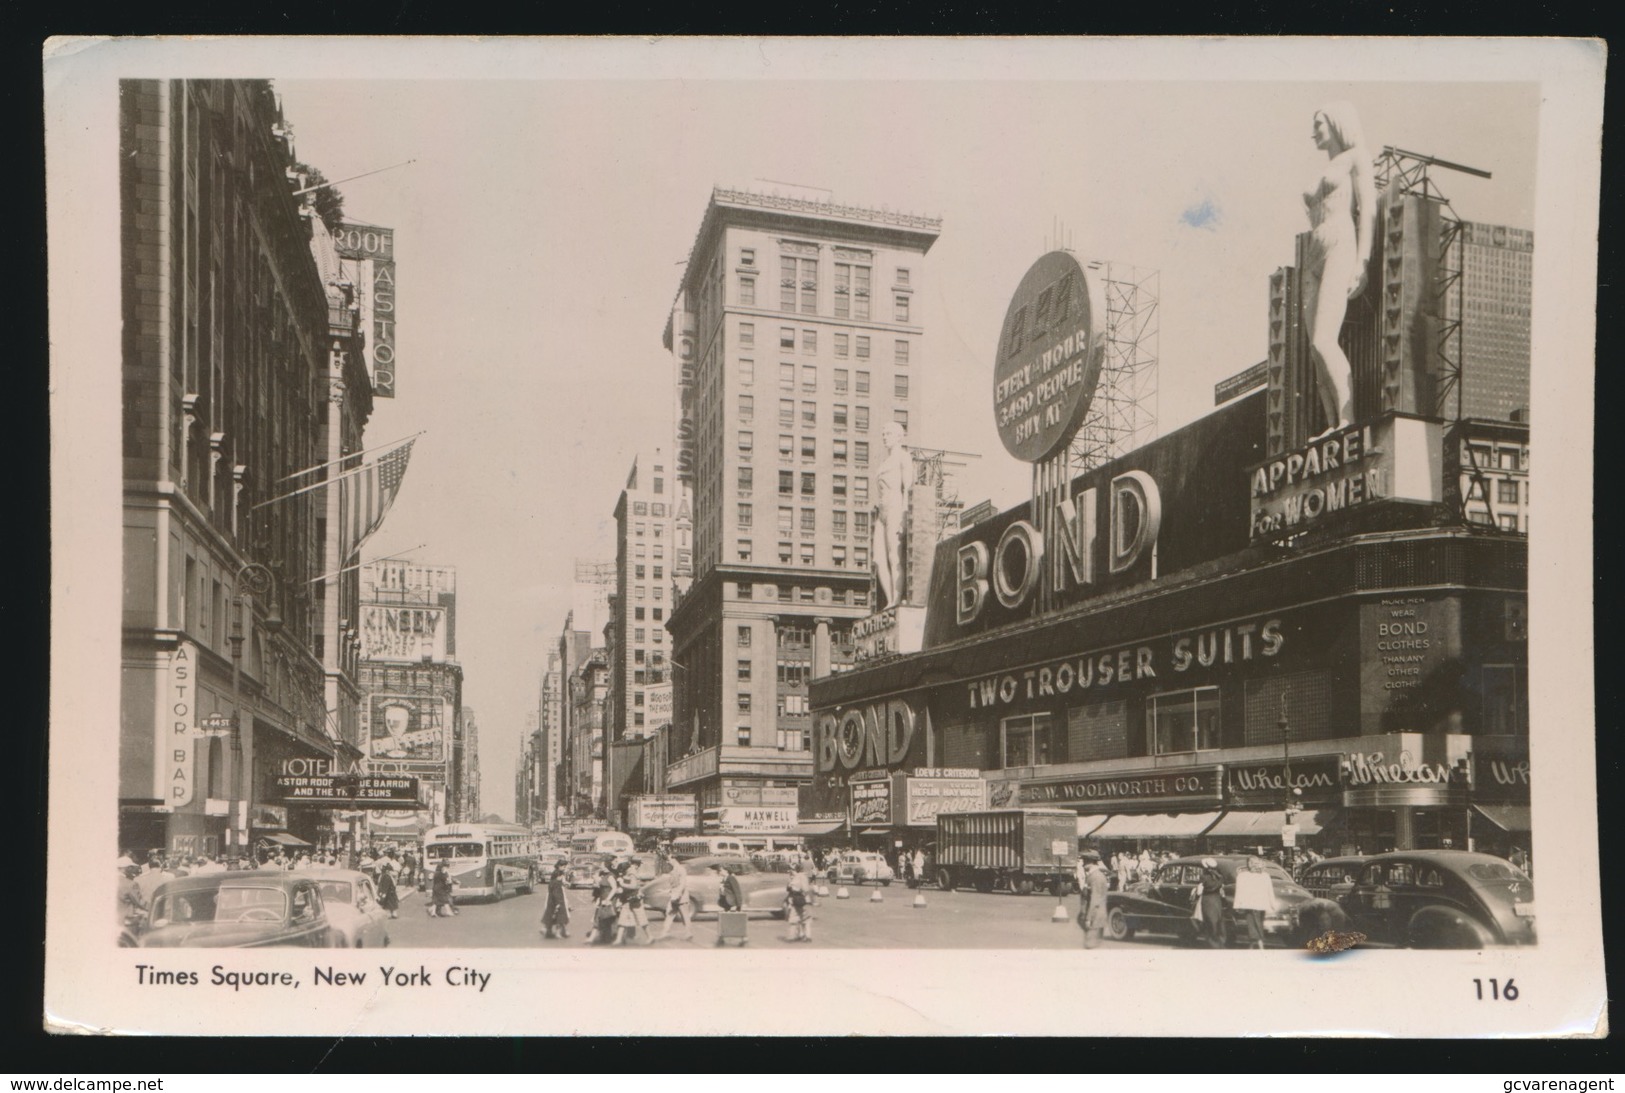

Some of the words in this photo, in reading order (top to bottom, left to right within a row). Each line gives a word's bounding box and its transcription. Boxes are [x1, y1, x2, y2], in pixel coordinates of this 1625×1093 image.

[334, 228, 392, 253] ROOF
[374, 266, 394, 390] ASTOR
[996, 363, 1033, 403] EVERY
[1042, 330, 1086, 374] HOUR
[1037, 358, 1083, 406] PEOPLE
[1015, 412, 1041, 445] BUY
[1045, 403, 1062, 429] AT
[1251, 424, 1384, 498] APPAREL
[1250, 509, 1281, 539] FOR
[1284, 467, 1383, 527] WOMEN
[957, 470, 1161, 626] BOND
[1391, 609, 1416, 617] WEAR
[1379, 621, 1428, 636] BOND
[1377, 639, 1430, 650] CLOTHES
[968, 675, 1017, 708] TWO
[1024, 646, 1156, 699] TROUSER
[1173, 619, 1284, 672] SUITS
[1383, 656, 1405, 664] THAN
[1388, 667, 1419, 676] OTHER
[173, 648, 189, 736] ASTOR
[210, 719, 220, 727] 44
[221, 719, 230, 727] ST
[819, 699, 917, 772] BOND
[172, 749, 187, 800] BAR
[277, 778, 308, 786] ASTOR
[374, 779, 410, 788] BARRON
[943, 768, 980, 778] CRITERION
[1239, 767, 1334, 790] Whelan
[294, 787, 313, 796] AND
[316, 788, 333, 796] THE
[368, 789, 392, 798] SUNS
[943, 787, 983, 797] HAYWARD
[1045, 786, 1059, 799] W.
[1063, 779, 1166, 798] WOOLWORTH
[744, 811, 790, 822] MAXWELL
